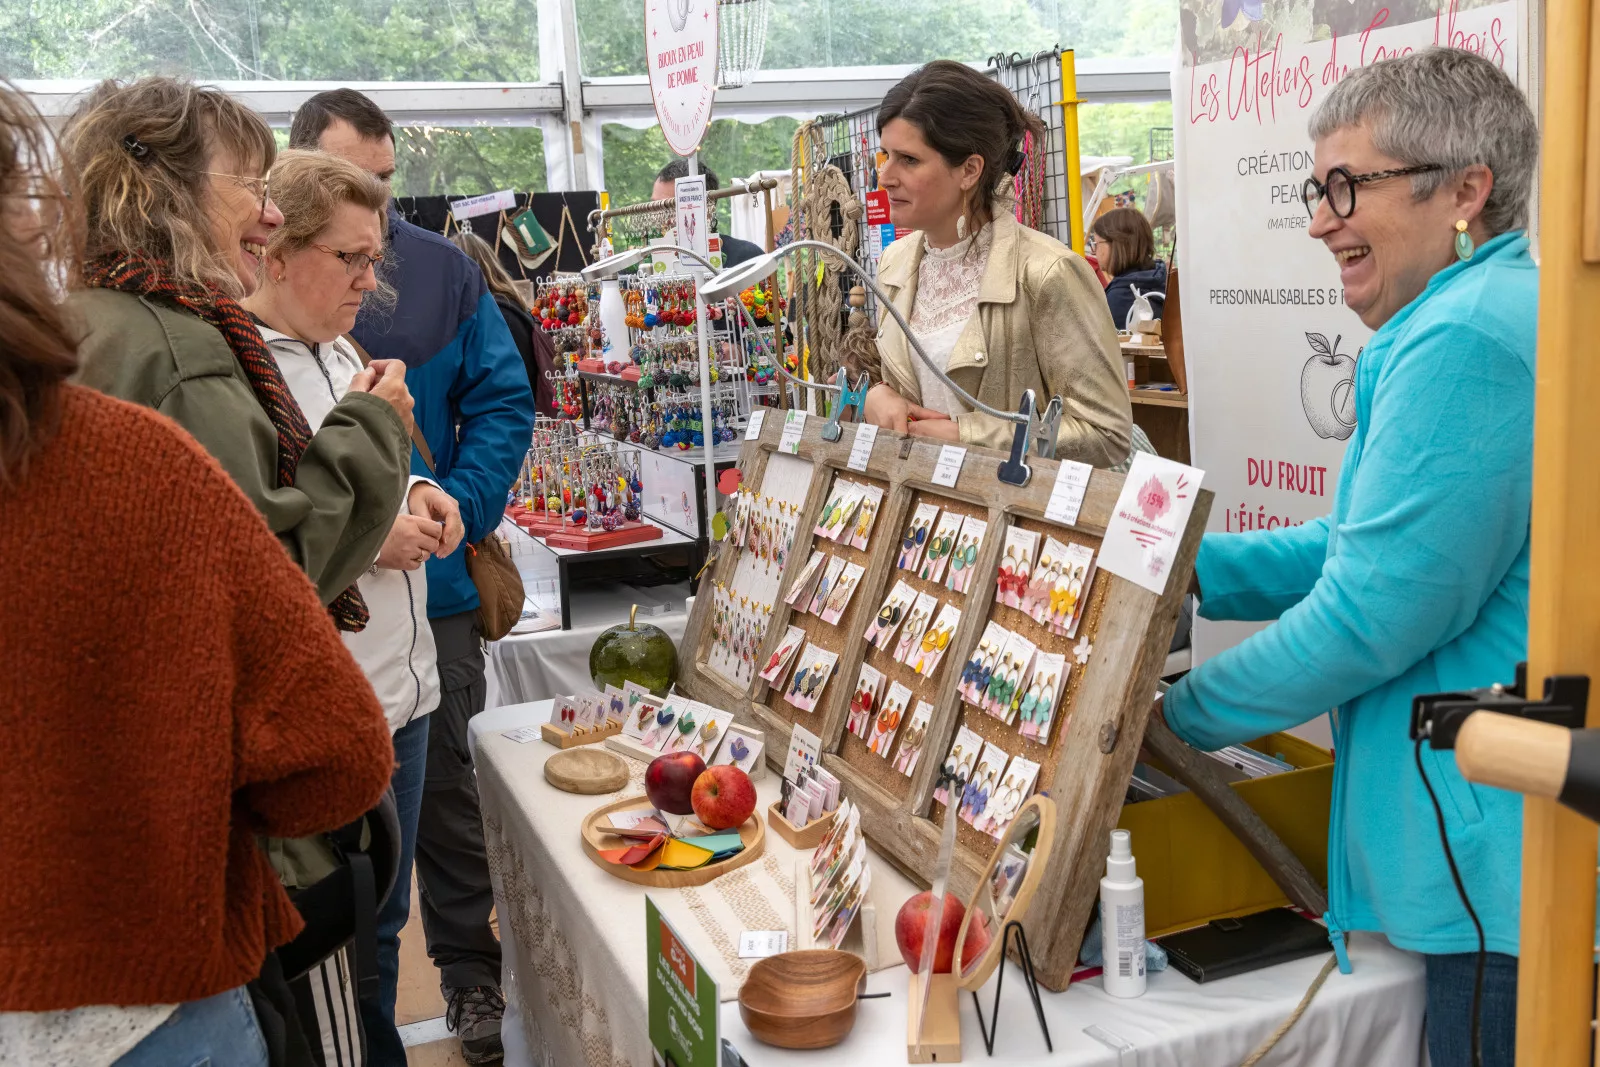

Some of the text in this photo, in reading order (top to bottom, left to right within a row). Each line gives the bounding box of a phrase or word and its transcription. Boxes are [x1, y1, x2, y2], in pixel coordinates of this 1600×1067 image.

[658, 41, 704, 69] BIJOUX EN PEAU
[667, 66, 699, 89] DE POMME
[1190, 51, 1221, 124] Les
[1227, 30, 1315, 126] Ateliers
[1209, 288, 1325, 305] PERSONNALISABLES
[1328, 288, 1338, 305] &
[1247, 457, 1327, 497] DU FRUIT
